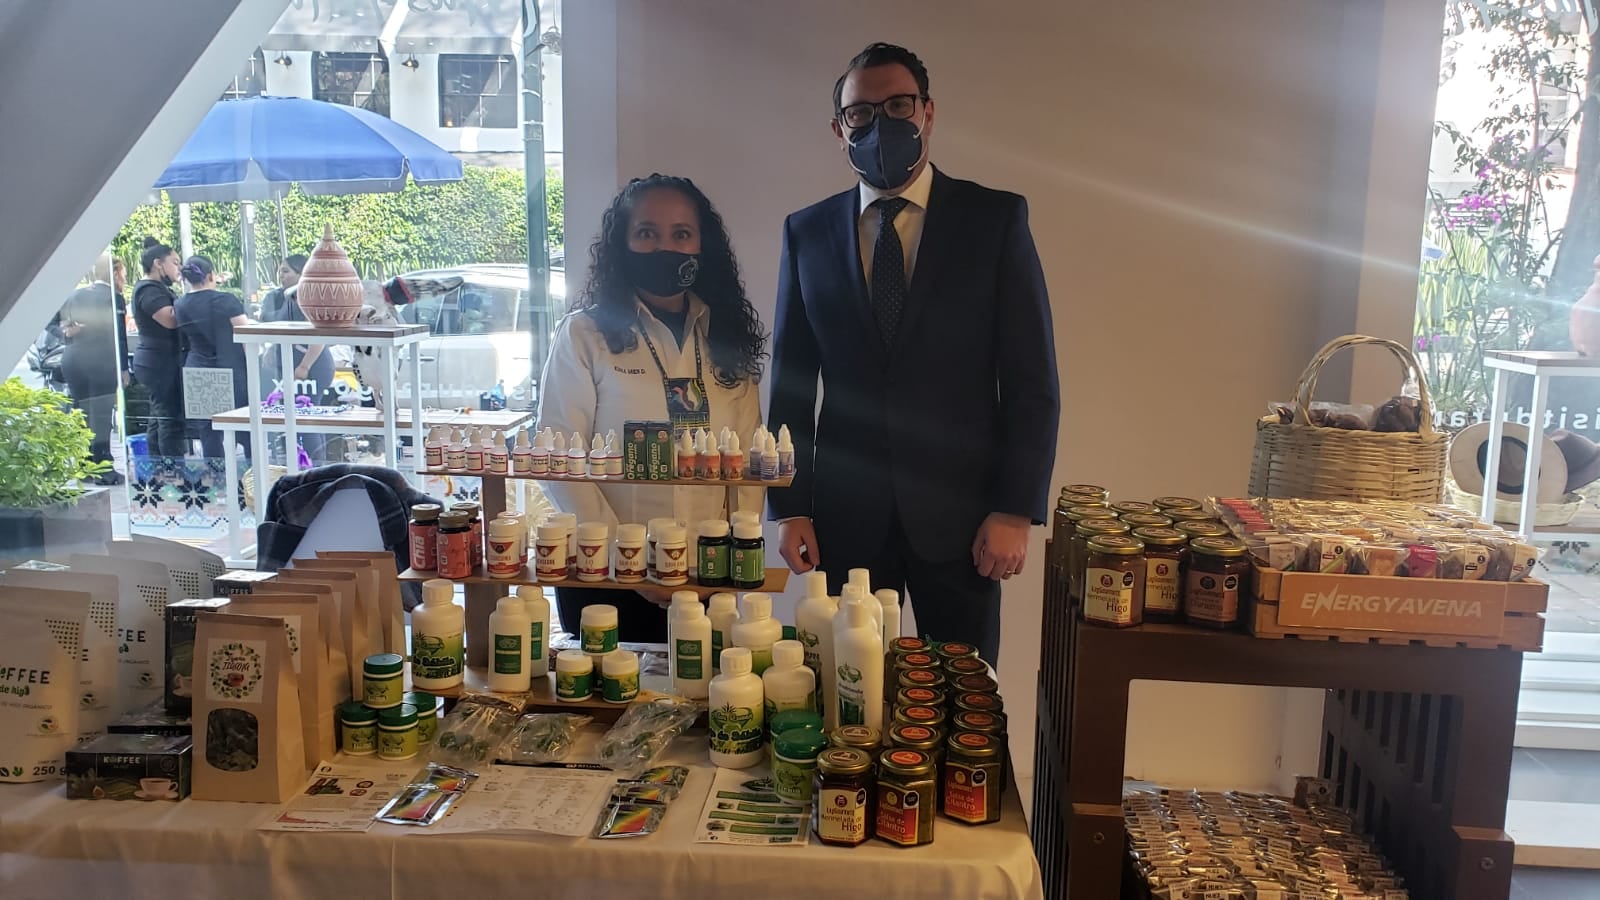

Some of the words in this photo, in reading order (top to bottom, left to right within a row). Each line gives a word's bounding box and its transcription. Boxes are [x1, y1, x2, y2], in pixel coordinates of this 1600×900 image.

[1300, 584, 1482, 617] ENERGYAVENA
[1106, 602, 1128, 614] Higo
[32, 766, 56, 776] 250
[841, 821, 862, 833] Higo
